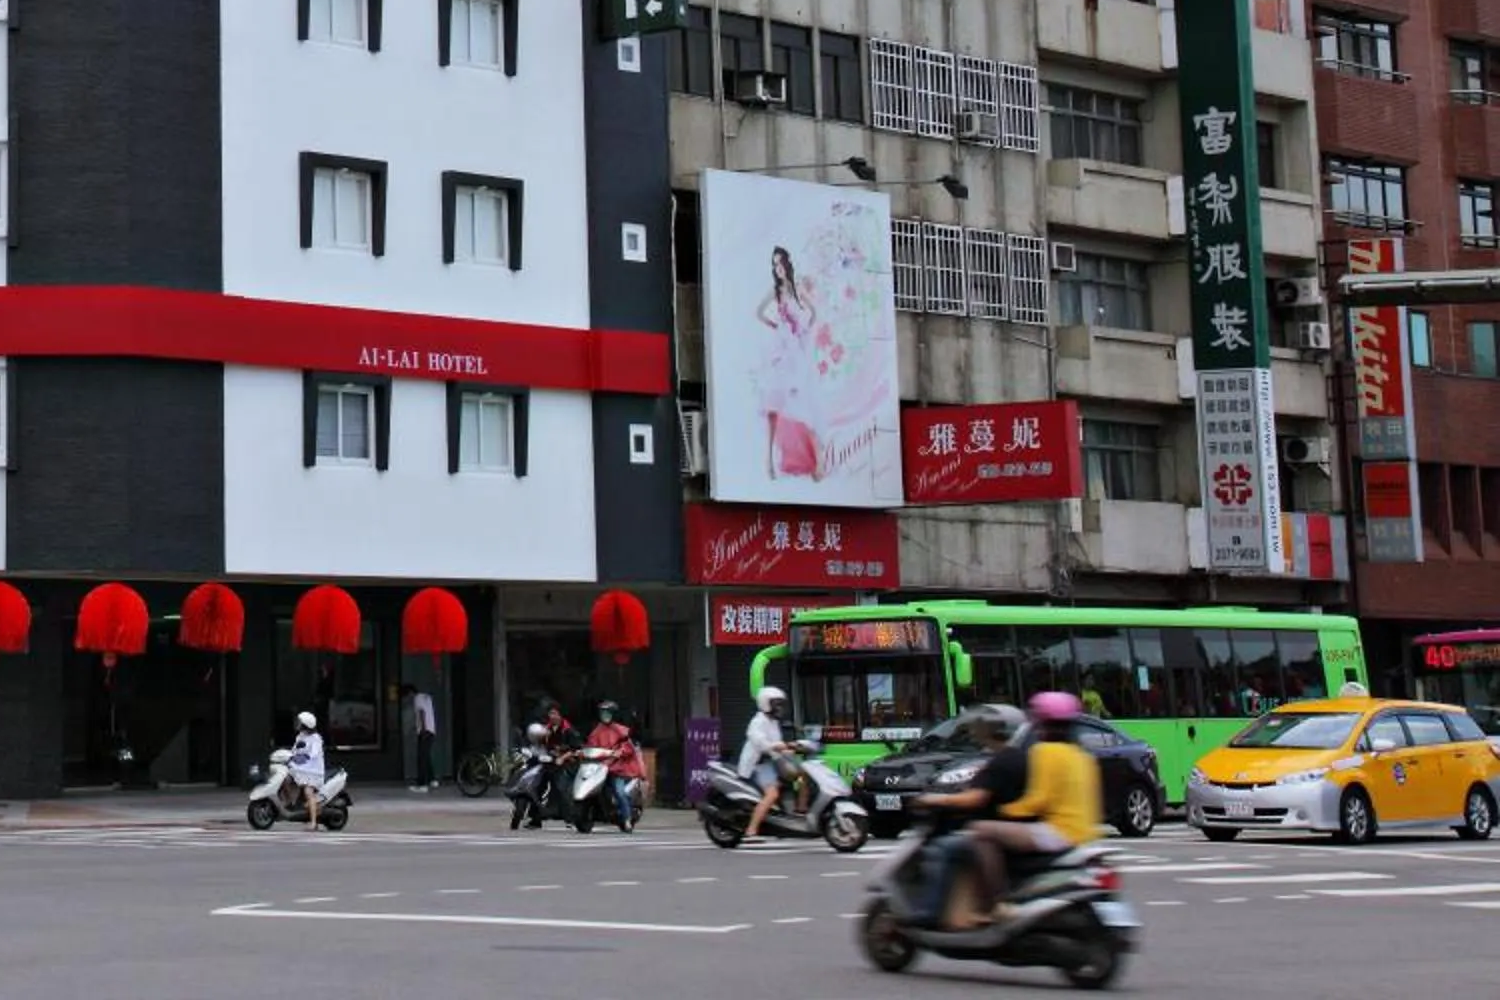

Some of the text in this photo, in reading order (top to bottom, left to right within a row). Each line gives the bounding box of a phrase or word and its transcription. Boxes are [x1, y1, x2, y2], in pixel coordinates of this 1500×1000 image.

[1349, 239, 1390, 414] mkita
[358, 347, 488, 374] AI-LAI HOTEL
[918, 417, 1041, 455] 雅蔓妮
